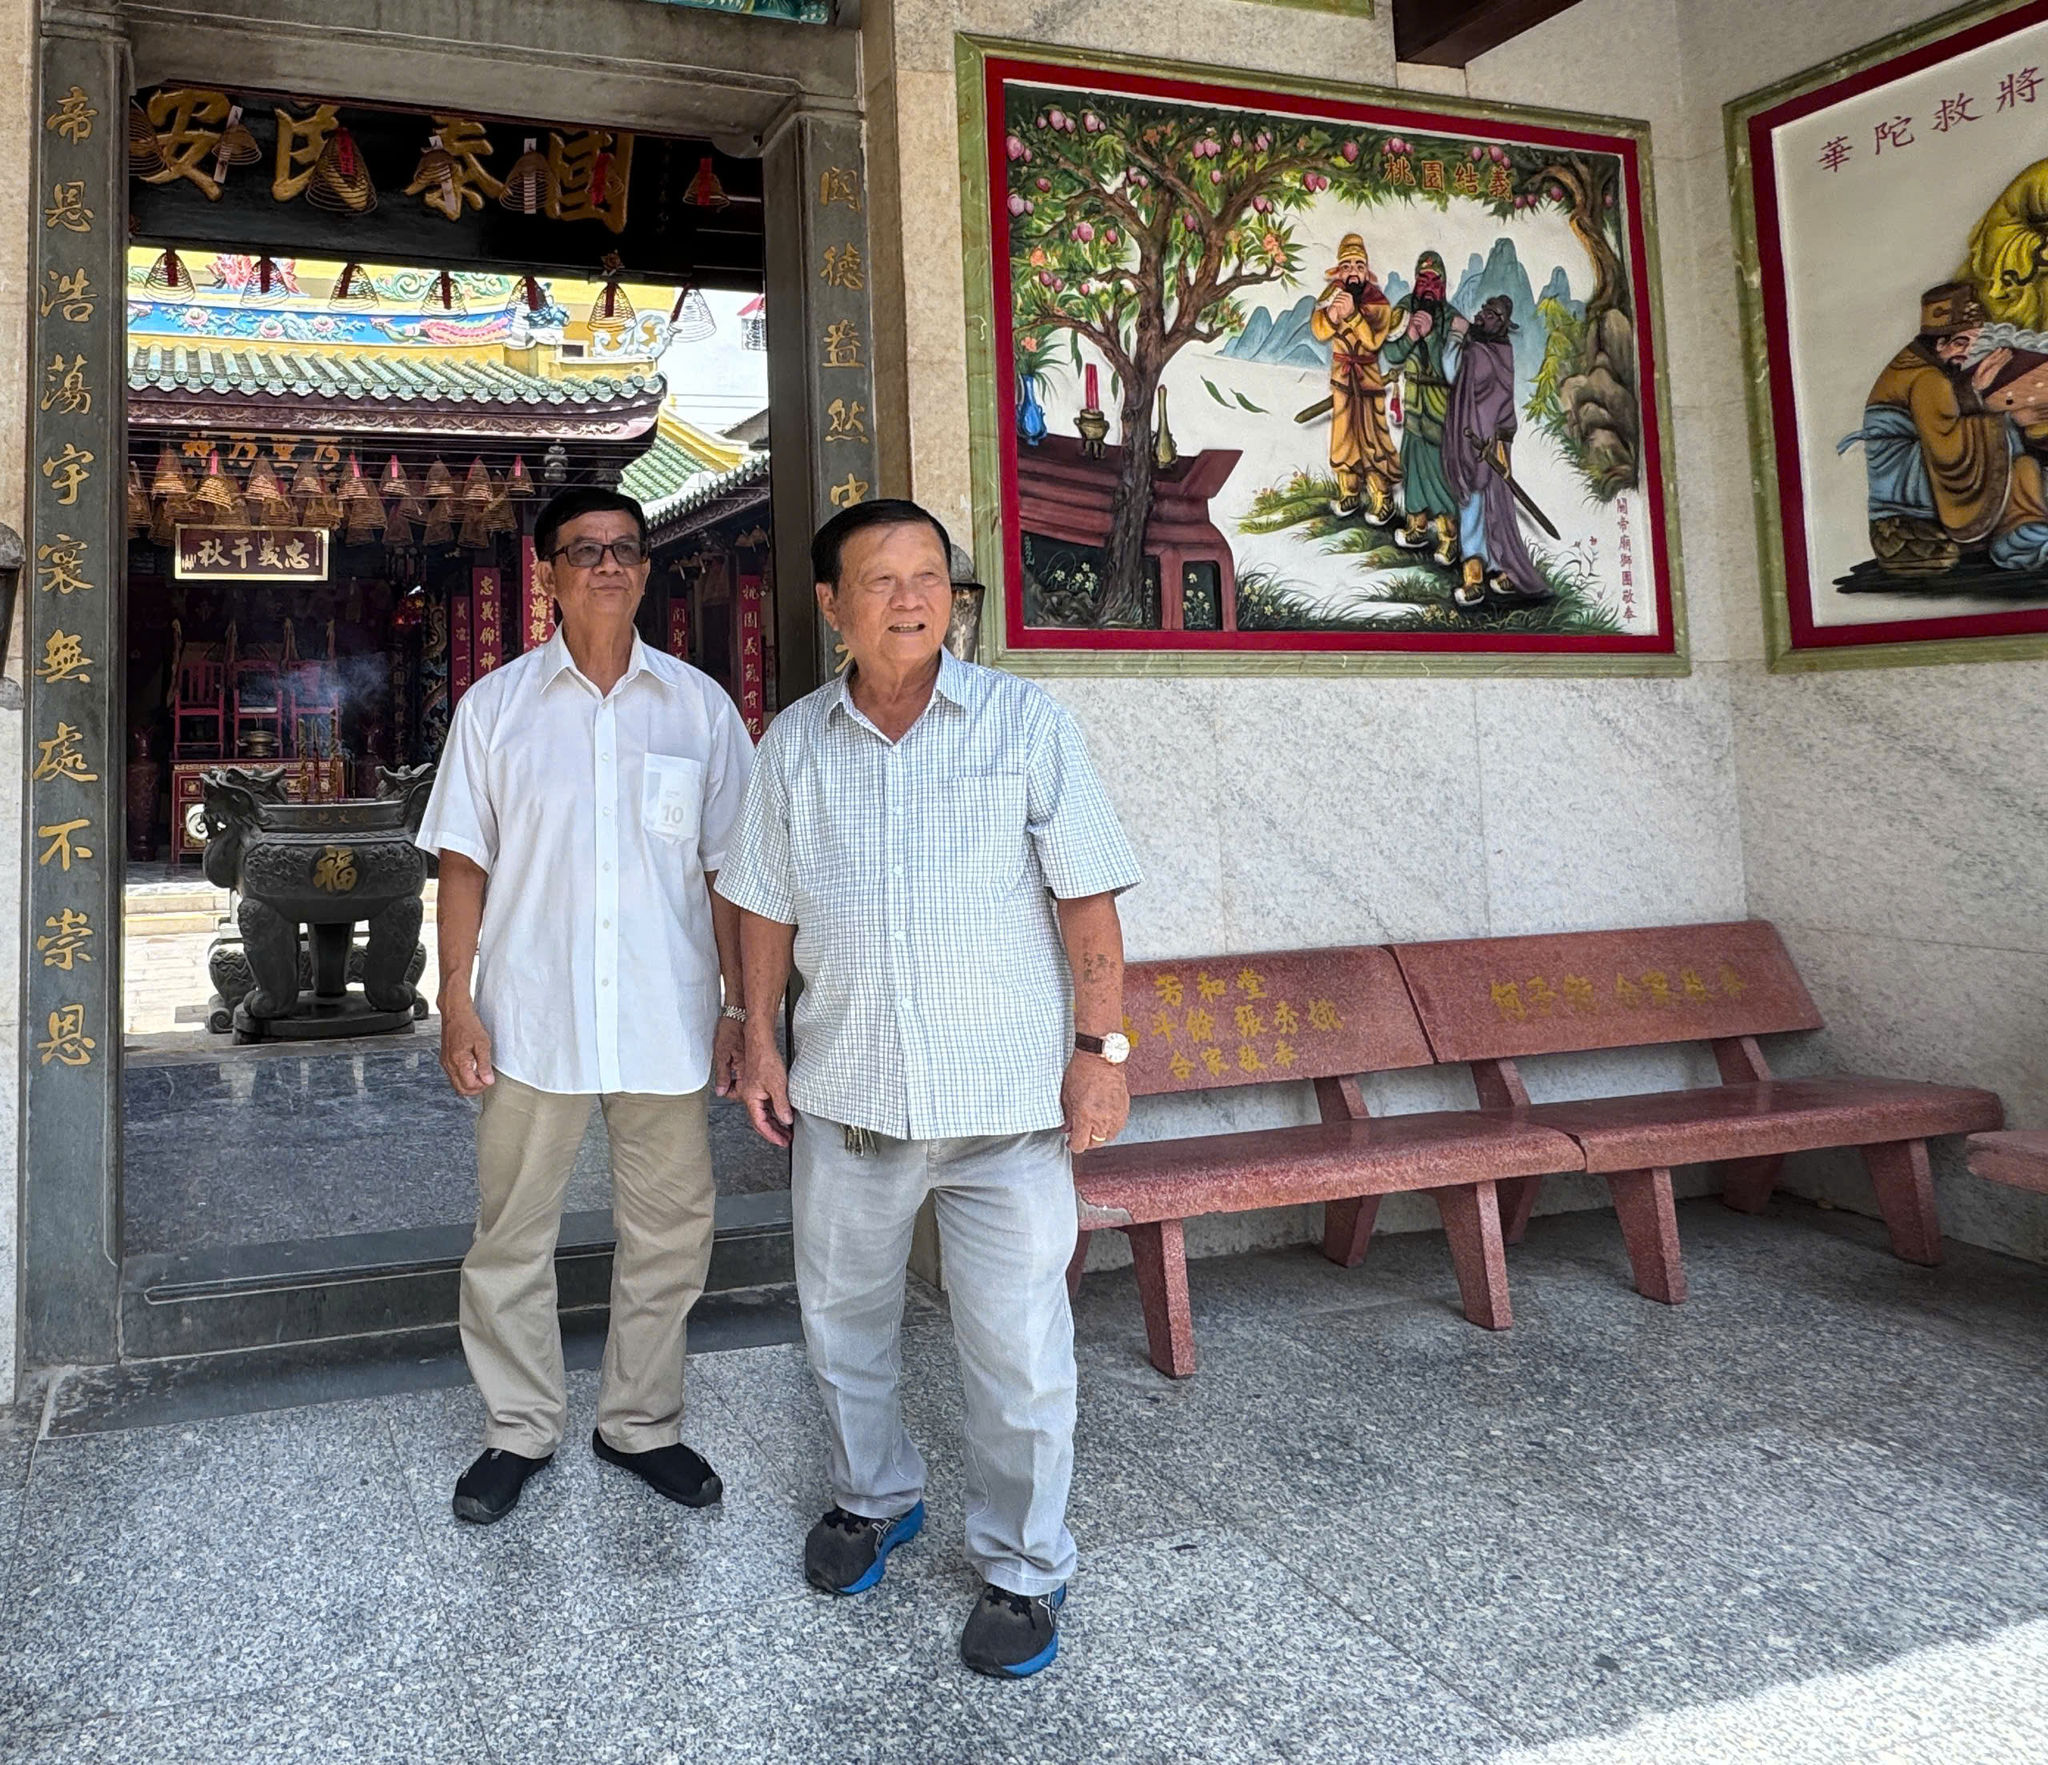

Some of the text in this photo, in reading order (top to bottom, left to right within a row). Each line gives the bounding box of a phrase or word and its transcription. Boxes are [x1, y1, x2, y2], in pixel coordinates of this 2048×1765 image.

[1817, 67, 2045, 173] 華陀救將
[138, 89, 635, 234] 國泰民安
[1382, 153, 1514, 202] 桃園結義
[313, 844, 358, 893] 福
